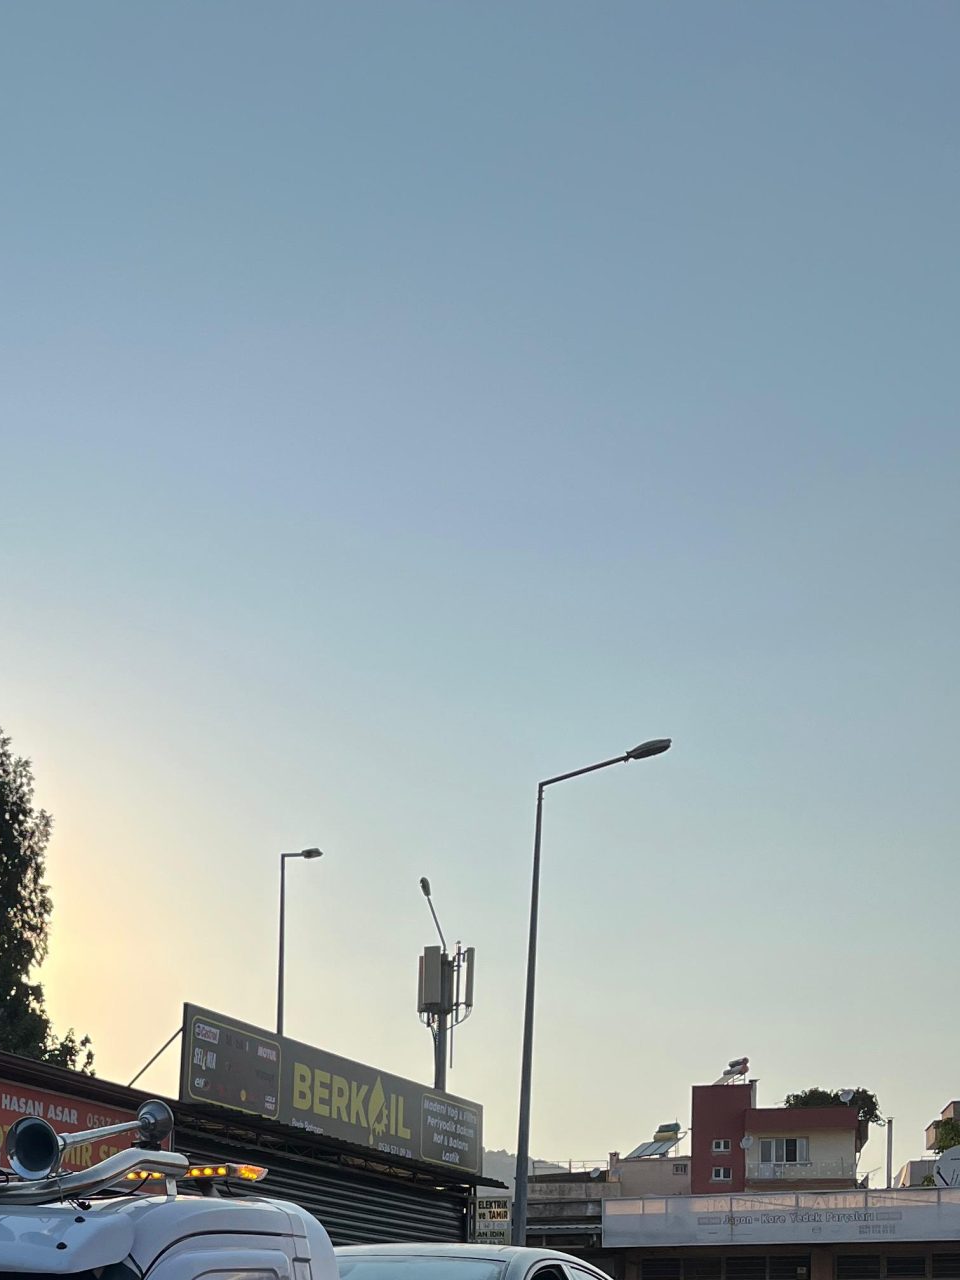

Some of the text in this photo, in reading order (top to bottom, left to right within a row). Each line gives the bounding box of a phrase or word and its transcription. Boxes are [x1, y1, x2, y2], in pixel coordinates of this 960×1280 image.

[1, 1093, 44, 1117] HASAN
[47, 1103, 78, 1125] ASAR
[761, 1213, 786, 1224] Kore
[790, 1212, 823, 1223] Yedek
